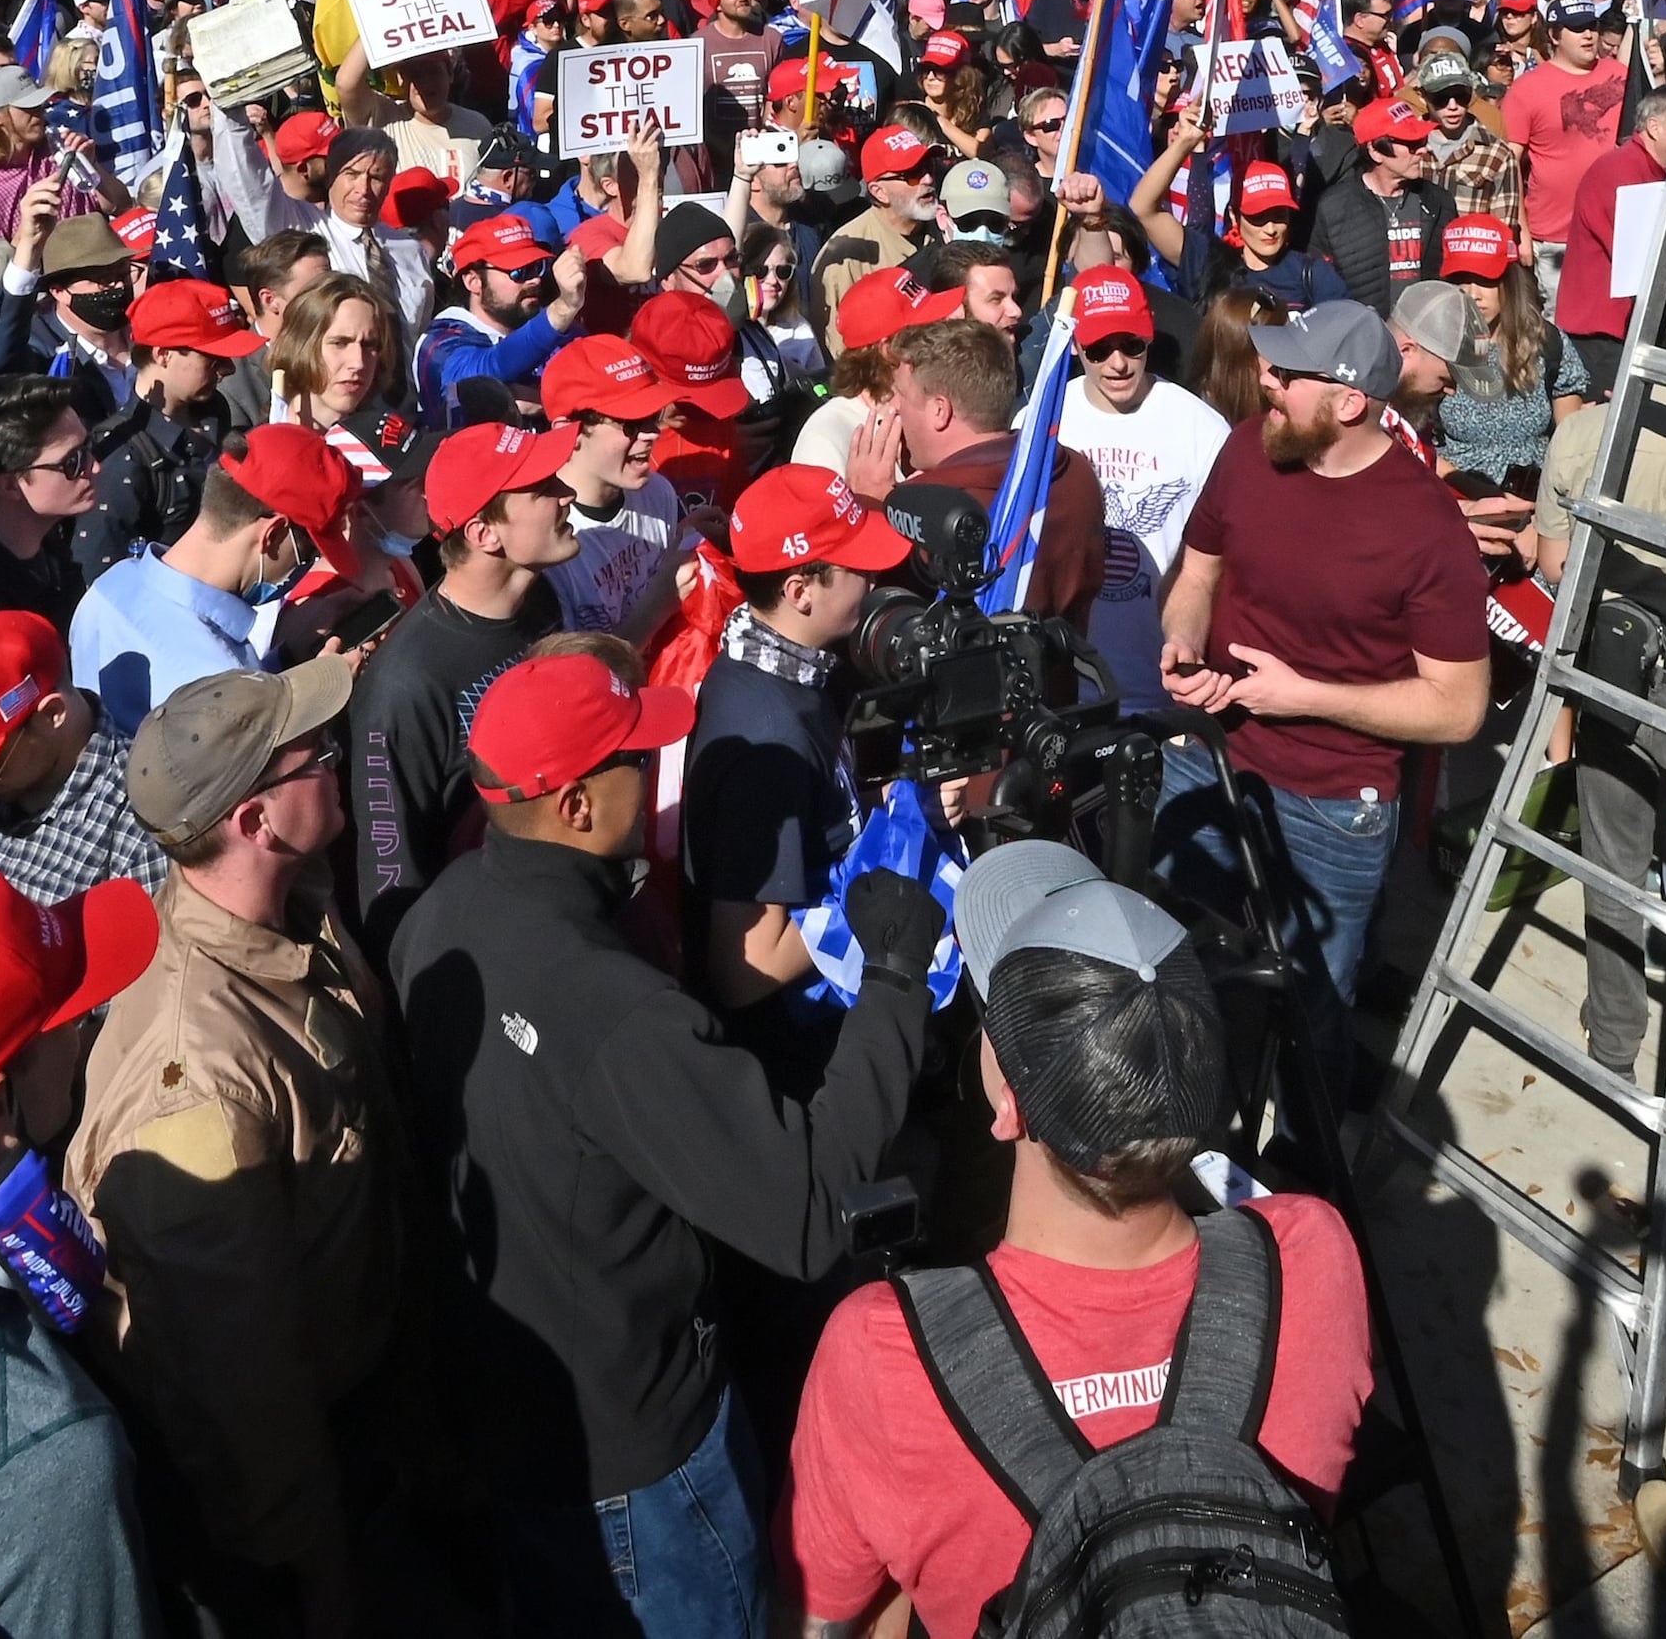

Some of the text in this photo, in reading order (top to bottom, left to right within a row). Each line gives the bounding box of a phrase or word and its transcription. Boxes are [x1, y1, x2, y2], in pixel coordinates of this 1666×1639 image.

[383, 11, 476, 49] STEAL
[587, 53, 673, 85] STOP
[1213, 51, 1289, 84] RECALL
[1430, 59, 1463, 77] USA
[604, 83, 655, 109] THE
[1081, 446, 1160, 473] MERICA
[782, 533, 809, 558] 45
[21, 1250, 58, 1280] MORE
